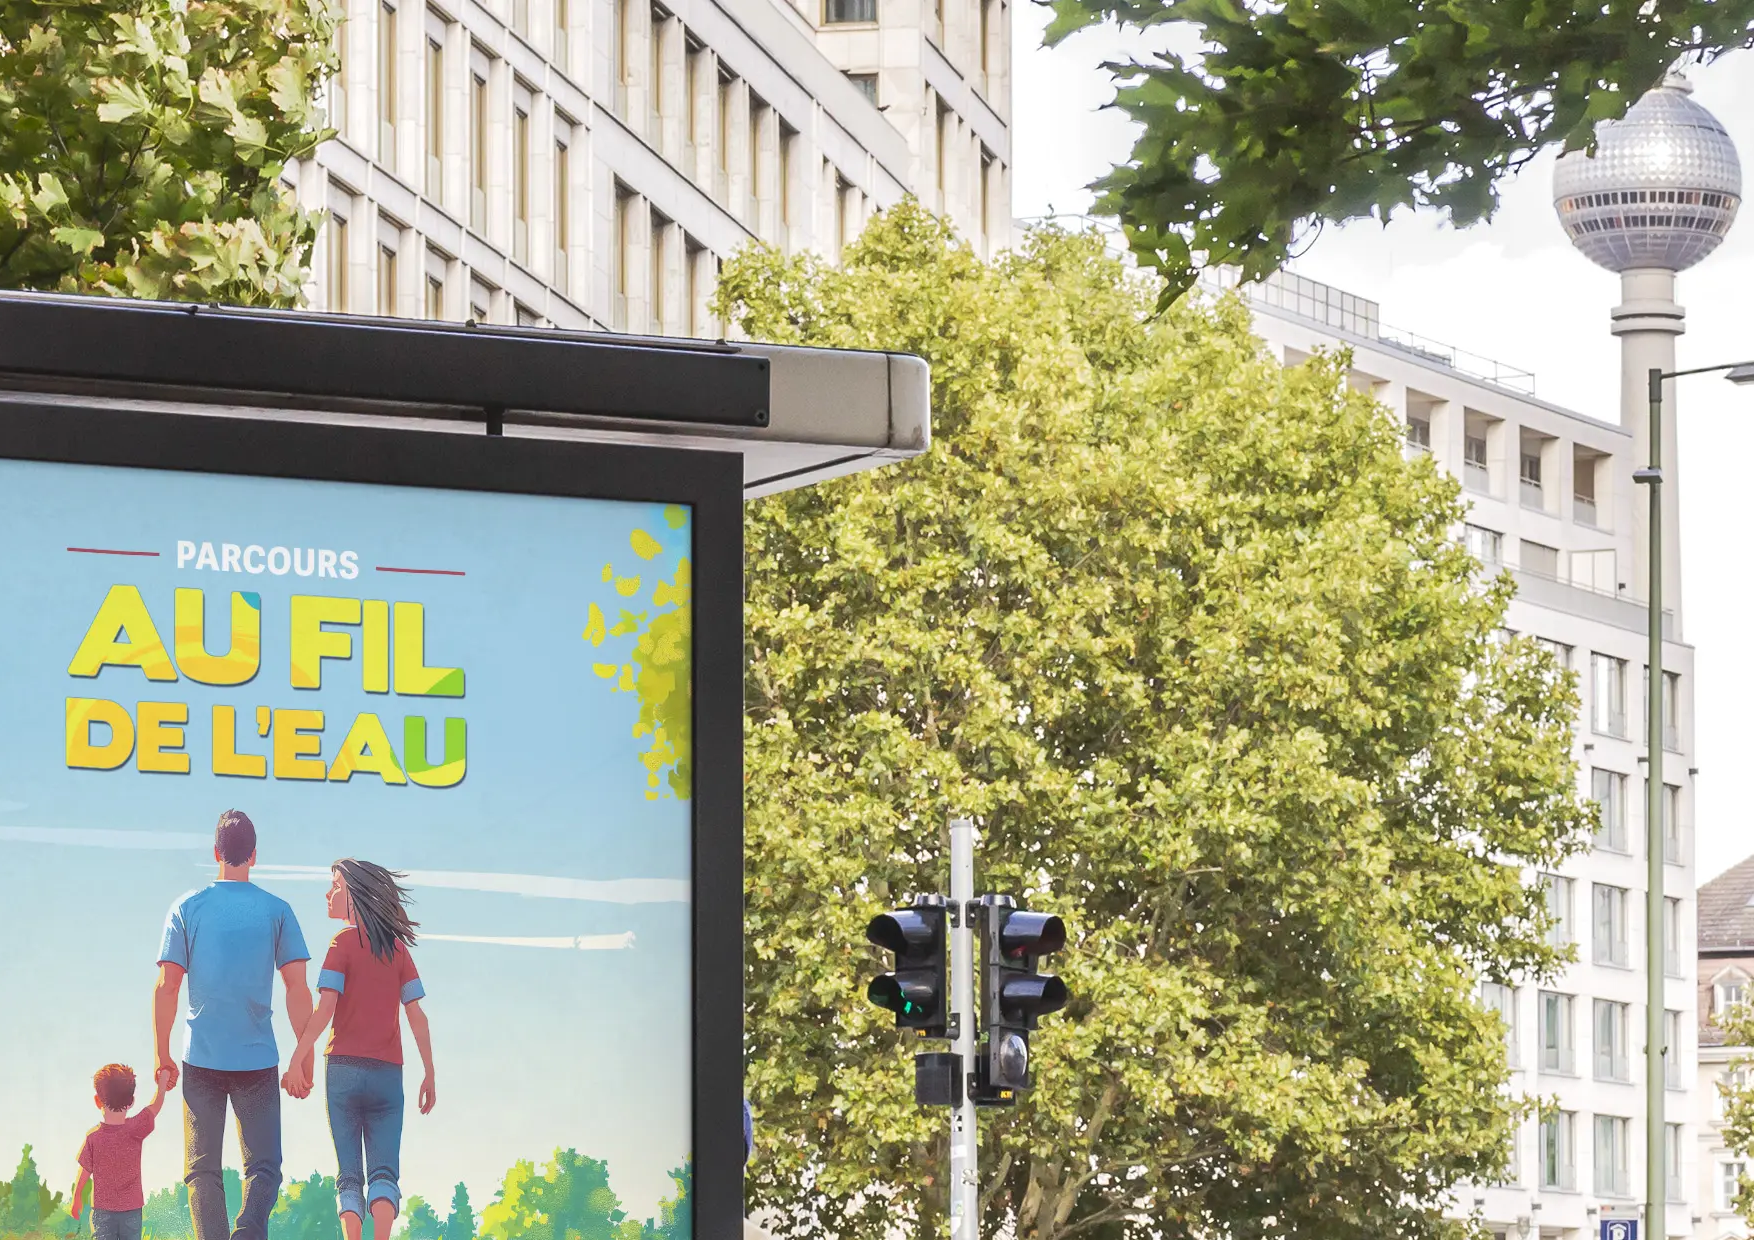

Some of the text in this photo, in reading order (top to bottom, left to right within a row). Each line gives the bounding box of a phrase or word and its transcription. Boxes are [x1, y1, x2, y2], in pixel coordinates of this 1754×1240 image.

[178, 541, 359, 579] PARCOURS
[67, 584, 465, 697] AU FIL
[65, 697, 467, 789] DE L'EAU
